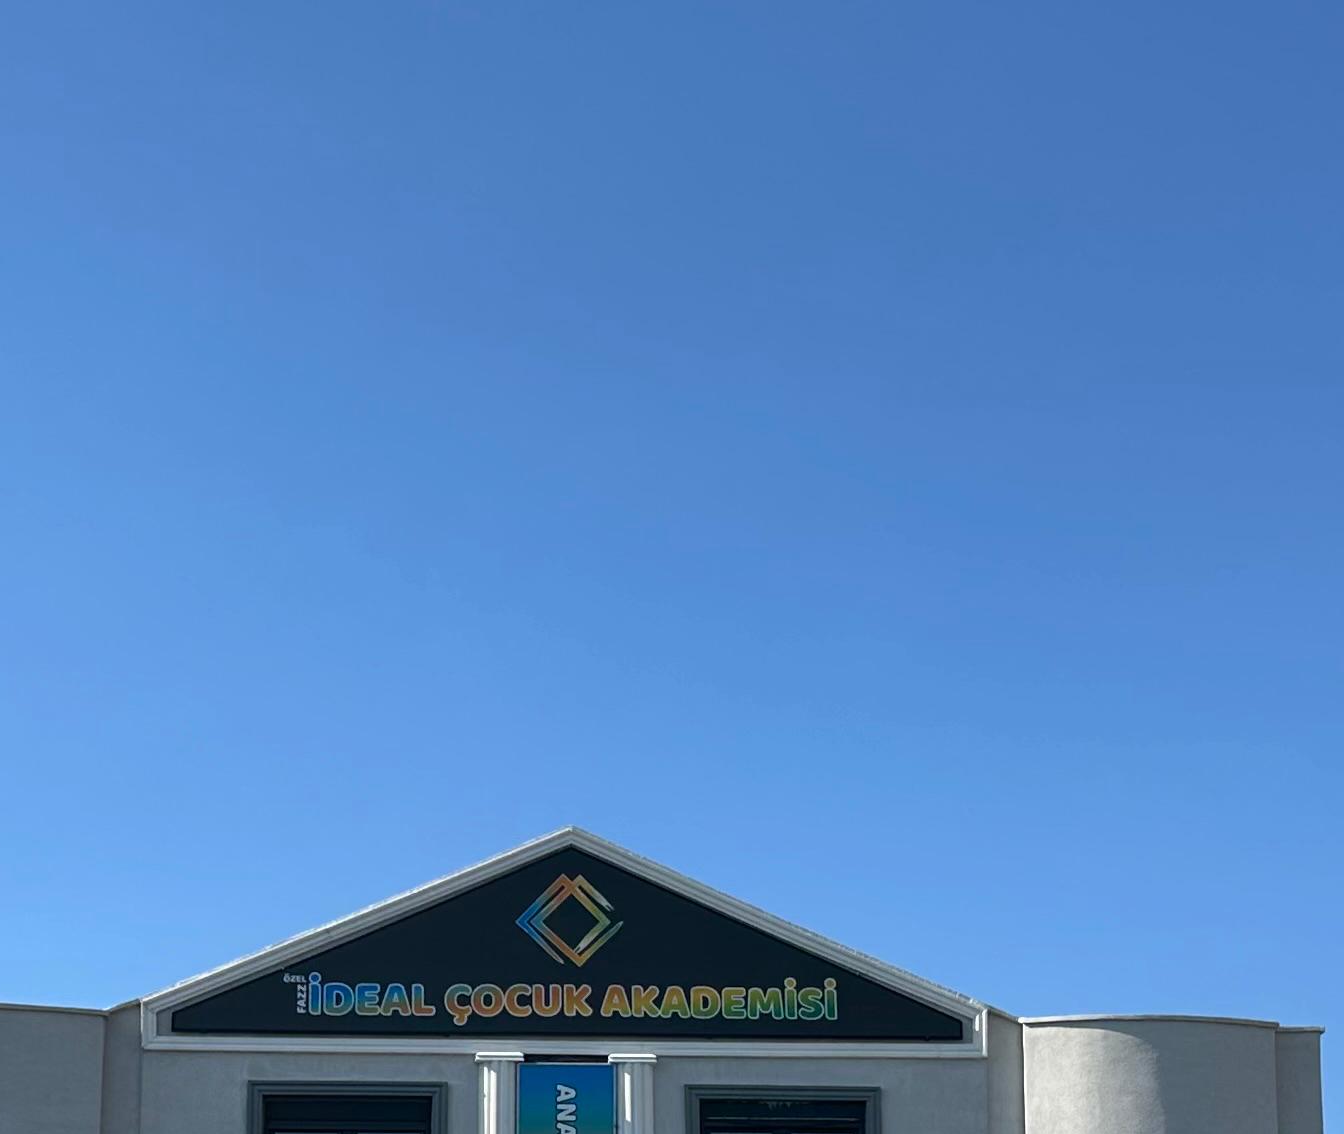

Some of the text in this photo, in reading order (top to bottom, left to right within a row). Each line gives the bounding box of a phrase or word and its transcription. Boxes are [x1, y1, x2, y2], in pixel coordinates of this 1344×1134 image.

[283, 973, 307, 983] ÖZEL
[297, 984, 306, 1014] FAZZ
[308, 971, 838, 1026] İDEAL ÇOCUK AKADEMİSİ
